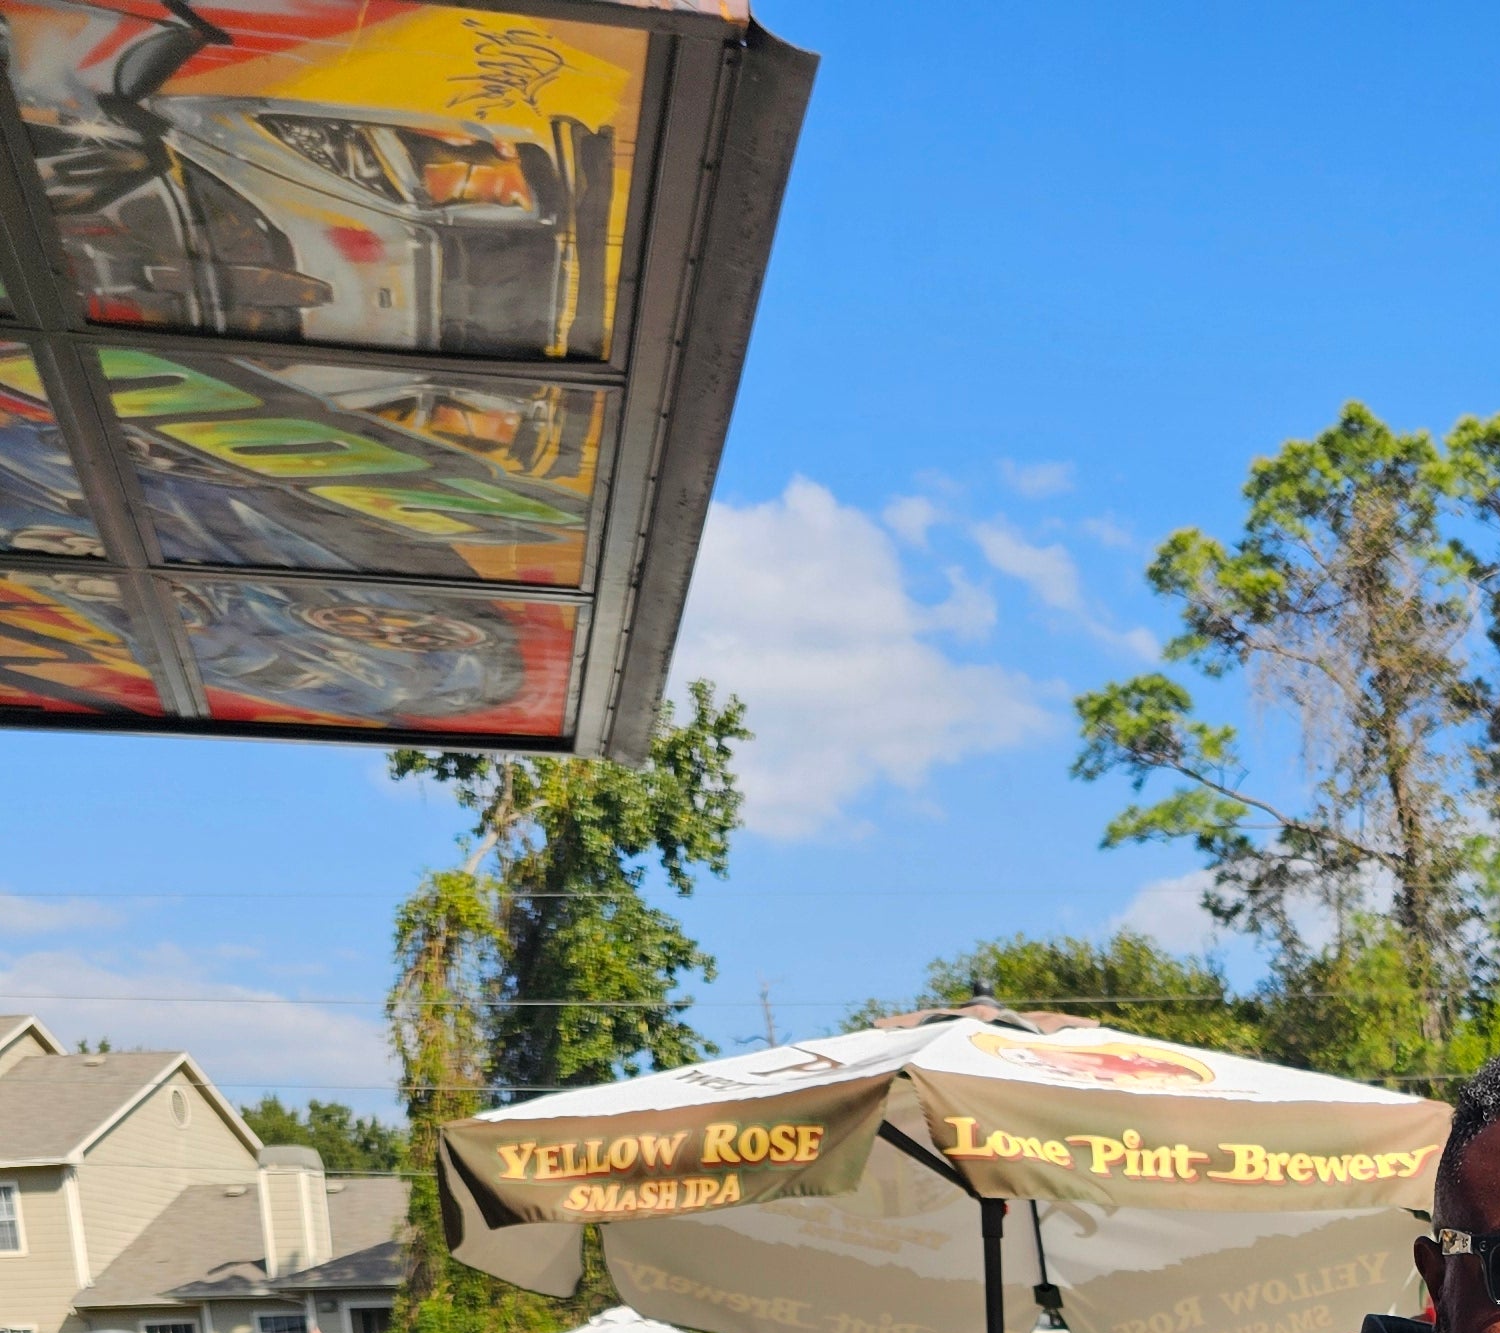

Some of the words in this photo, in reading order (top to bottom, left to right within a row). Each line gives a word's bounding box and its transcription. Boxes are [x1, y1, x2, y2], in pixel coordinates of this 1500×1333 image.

[497, 1130, 687, 1179] YELLOW
[701, 1122, 825, 1165] ROSE
[943, 1115, 1071, 1167] Lone
[1065, 1128, 1209, 1182] Pint
[1207, 1143, 1440, 1186] Brewery
[563, 1179, 678, 1213] SMASH
[683, 1173, 741, 1208] IPA
